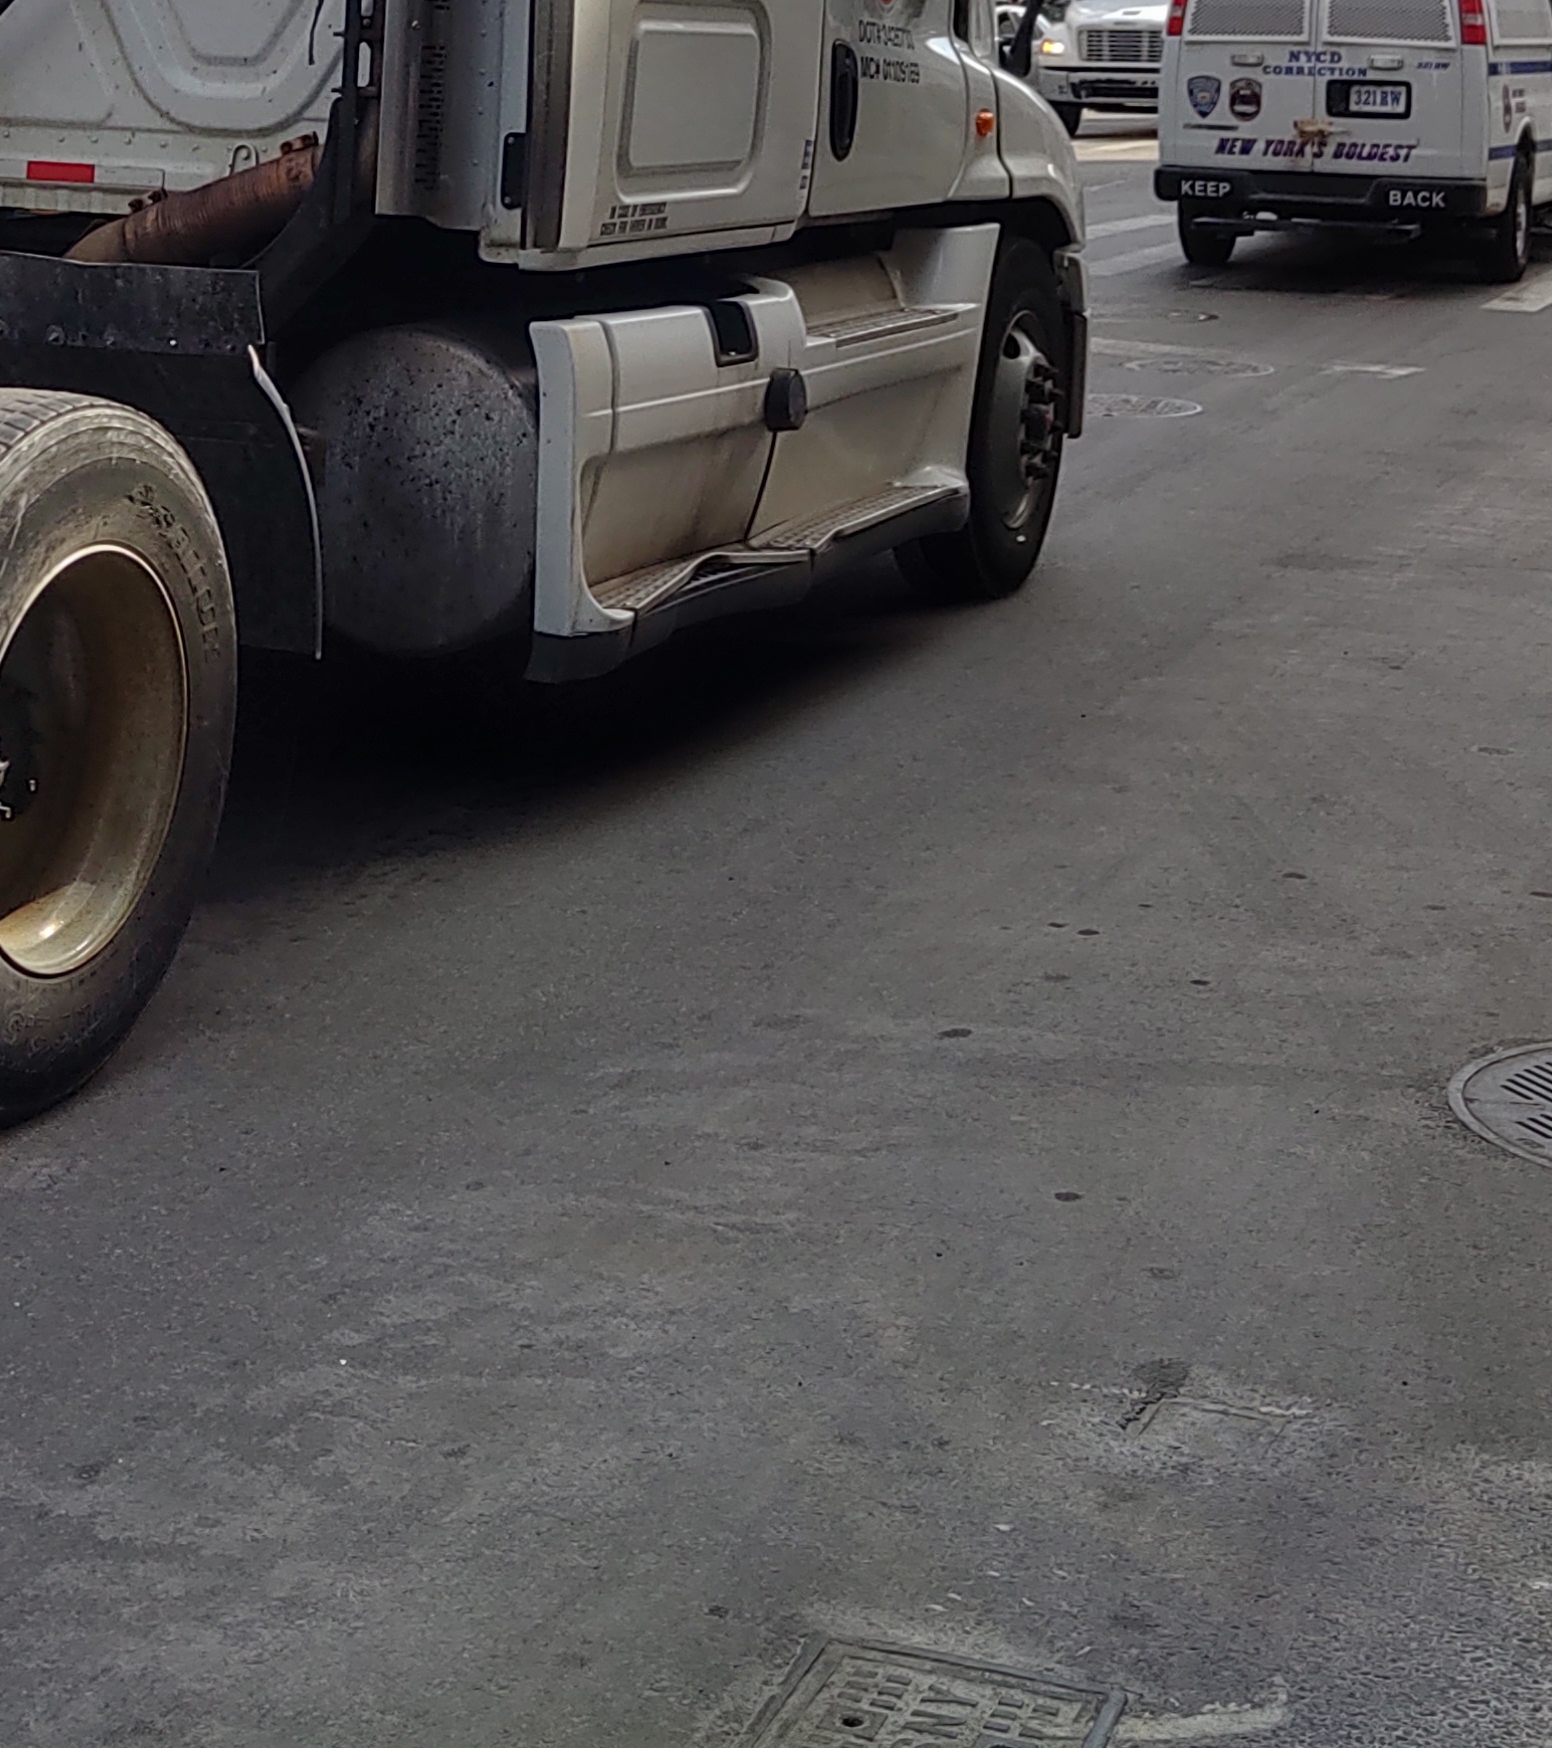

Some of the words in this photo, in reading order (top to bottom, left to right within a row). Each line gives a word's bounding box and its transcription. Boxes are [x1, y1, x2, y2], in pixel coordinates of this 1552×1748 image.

[1262, 64, 1368, 78] CORRECTION
[1215, 138, 1256, 156] NEW
[1262, 138, 1325, 159] YORK'S
[1331, 141, 1419, 163] BOLDEST
[1180, 180, 1231, 198] KEEP
[1388, 190, 1446, 208] BACK
